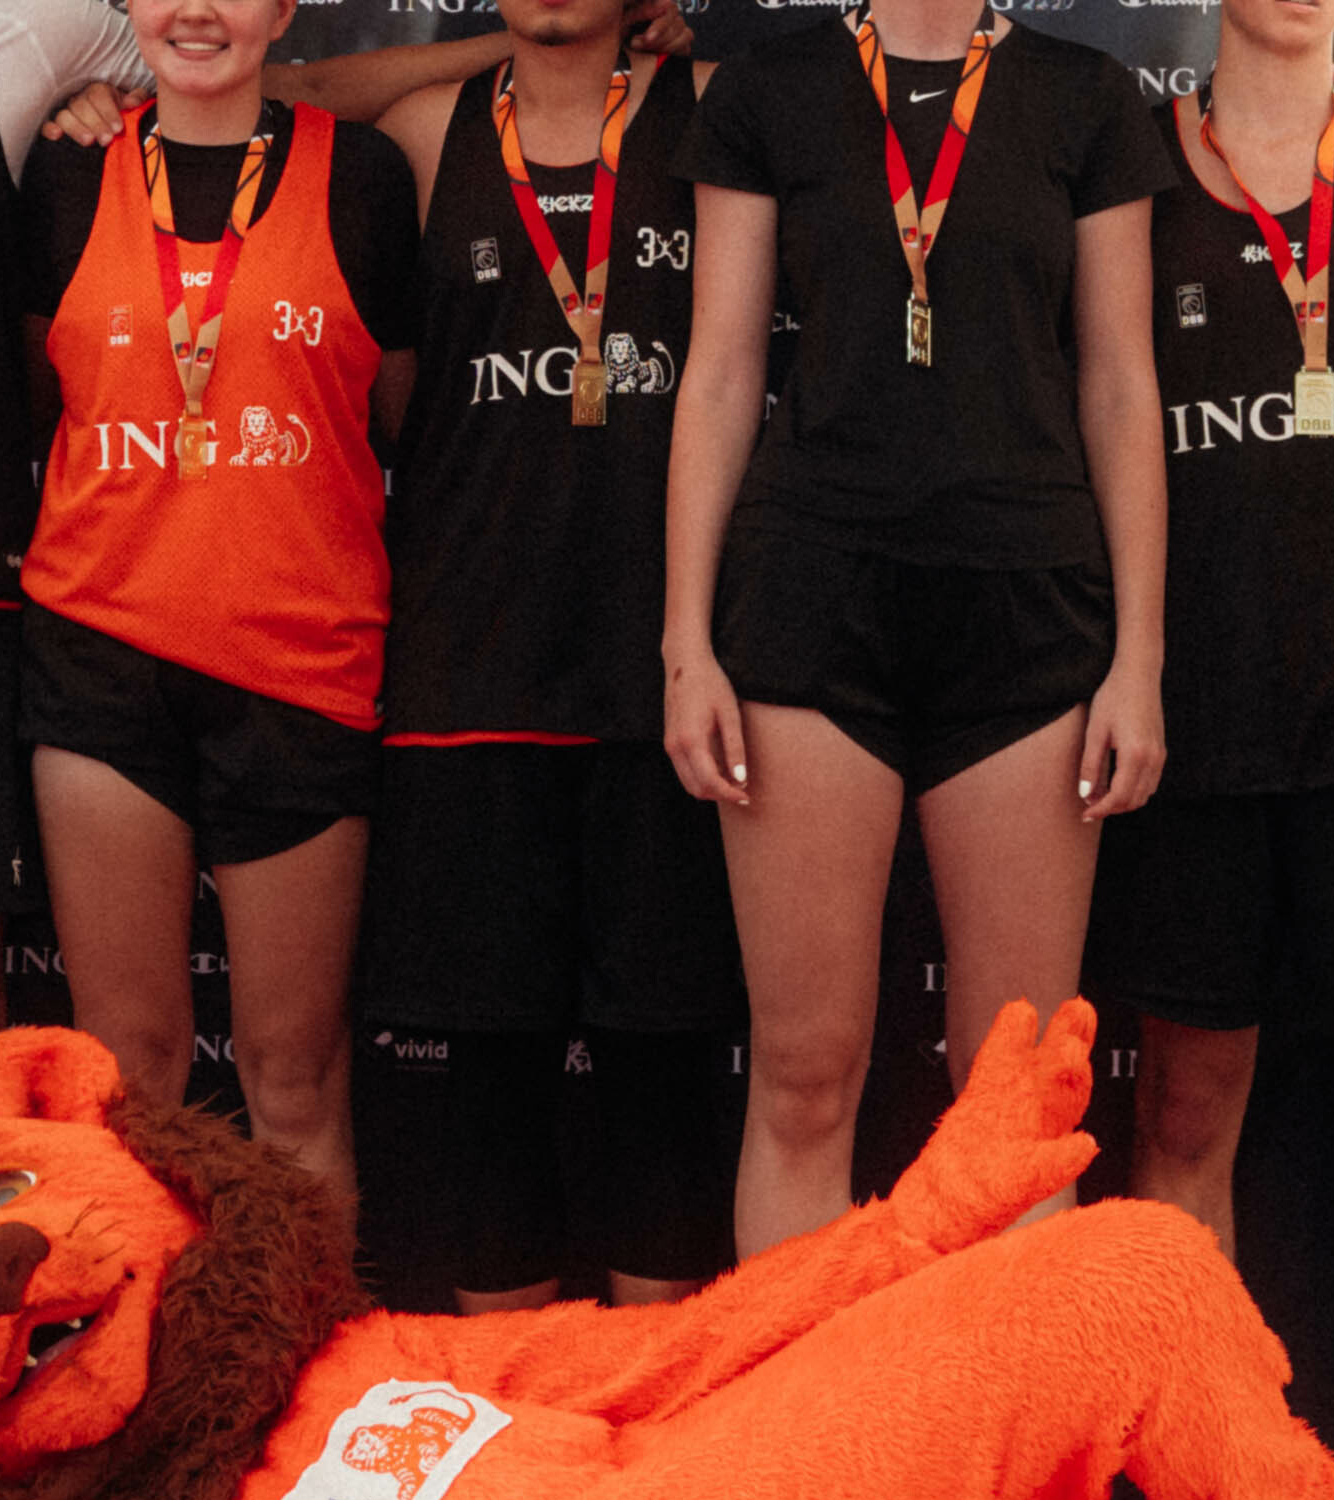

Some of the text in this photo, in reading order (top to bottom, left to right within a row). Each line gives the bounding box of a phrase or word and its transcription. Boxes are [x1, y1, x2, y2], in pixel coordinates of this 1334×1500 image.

[1128, 67, 1198, 96] NG
[469, 347, 579, 405] ING
[1168, 392, 1296, 454] ING
